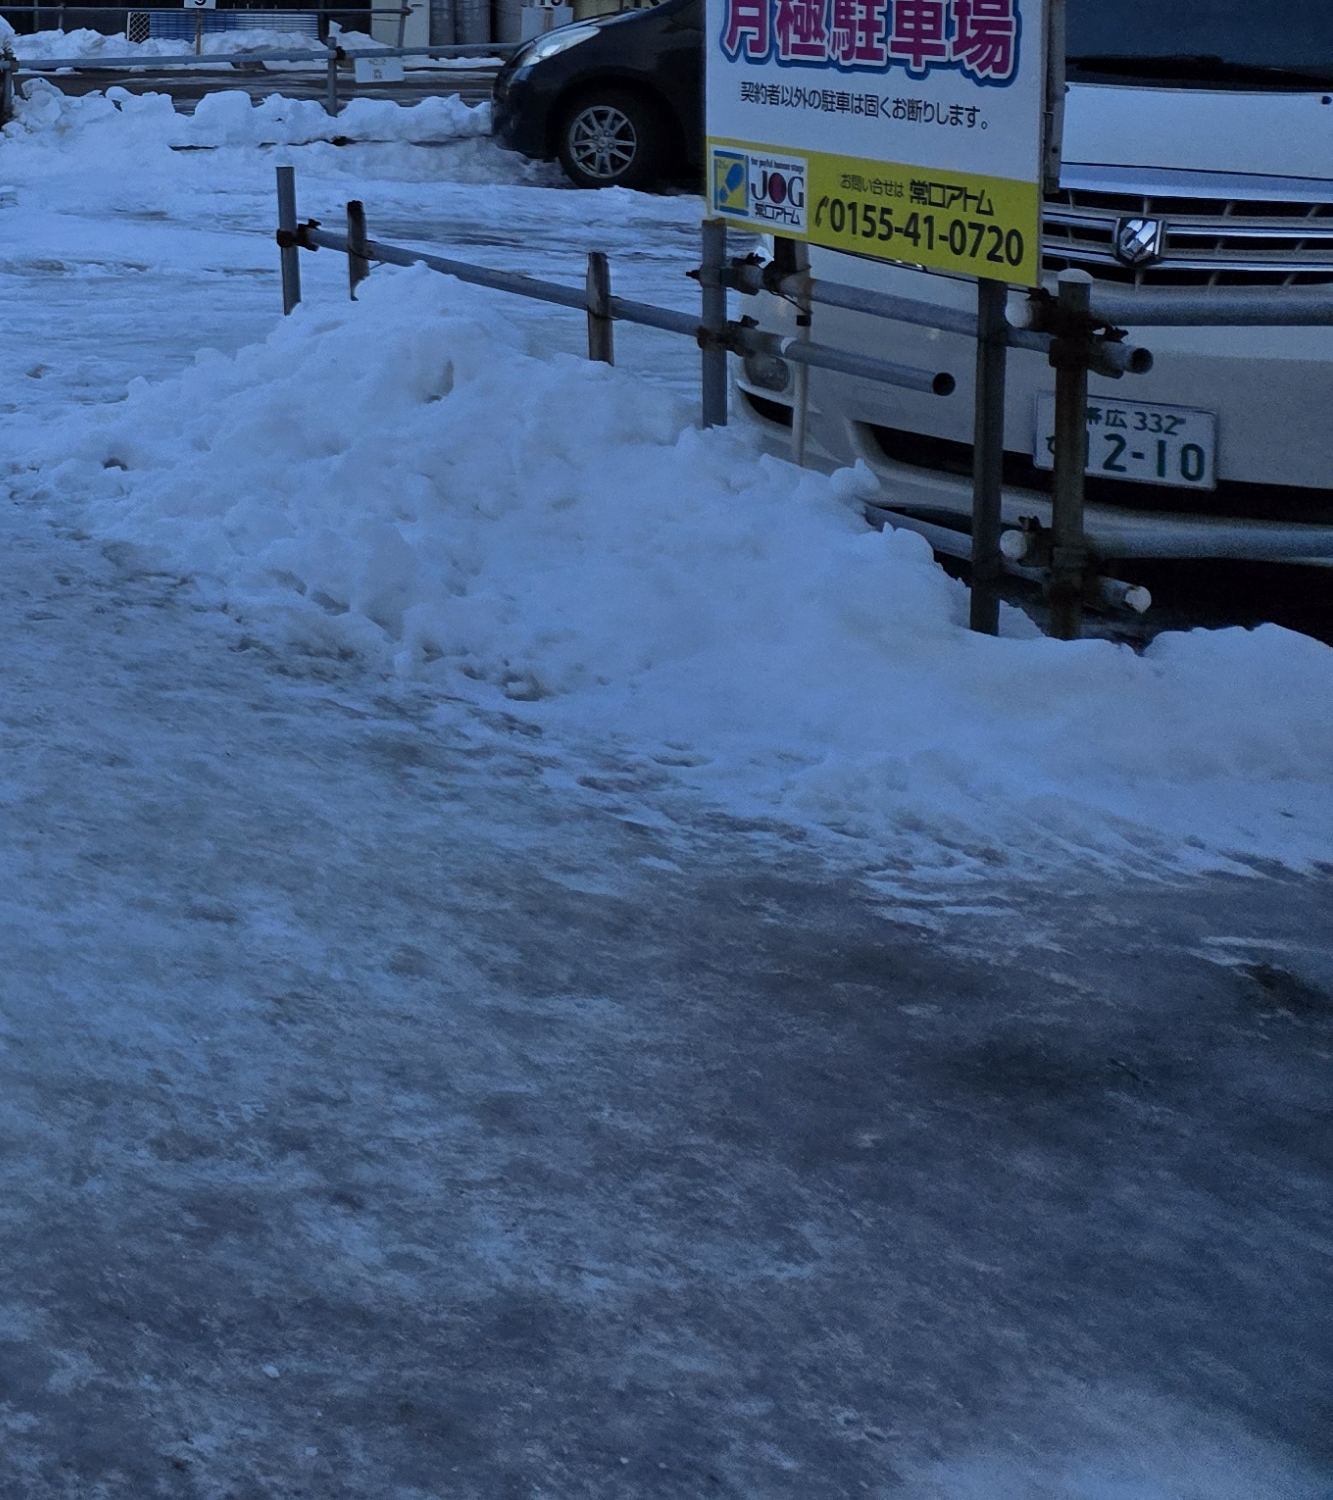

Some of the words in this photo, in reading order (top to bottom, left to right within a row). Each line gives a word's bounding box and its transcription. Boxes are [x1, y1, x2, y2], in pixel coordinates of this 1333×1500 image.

[740, 81, 988, 130] 契約者以外の駐車は固くお断りします。
[751, 170, 804, 208] JOG
[840, 174, 904, 198] お問い合せは
[909, 179, 994, 216] 常口アトム
[830, 198, 1024, 266] 0155-41-0720
[1134, 411, 1179, 436] 332
